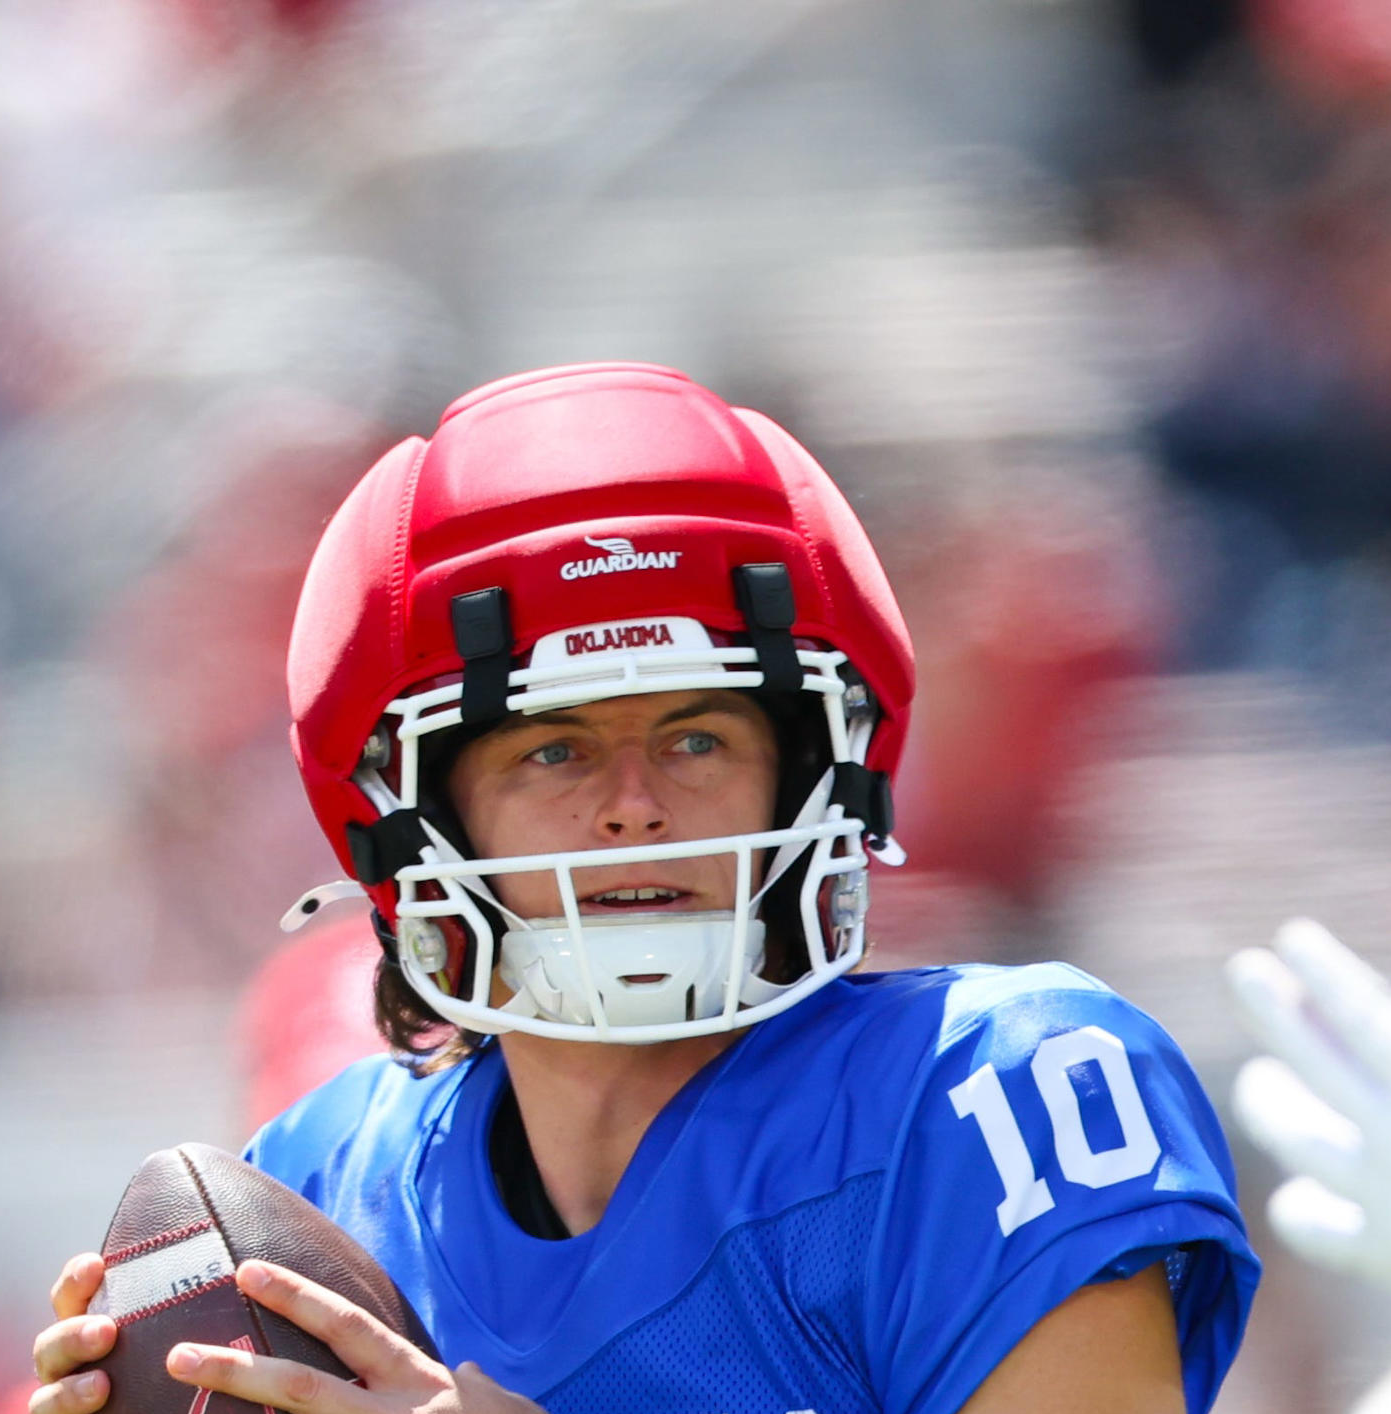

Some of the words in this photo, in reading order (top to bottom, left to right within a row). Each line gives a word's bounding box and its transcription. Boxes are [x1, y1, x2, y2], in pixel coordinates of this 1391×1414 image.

[560, 552, 677, 580] GUARDIAN
[565, 624, 674, 656] OKLAHOMA
[947, 1025, 1161, 1238] 10
